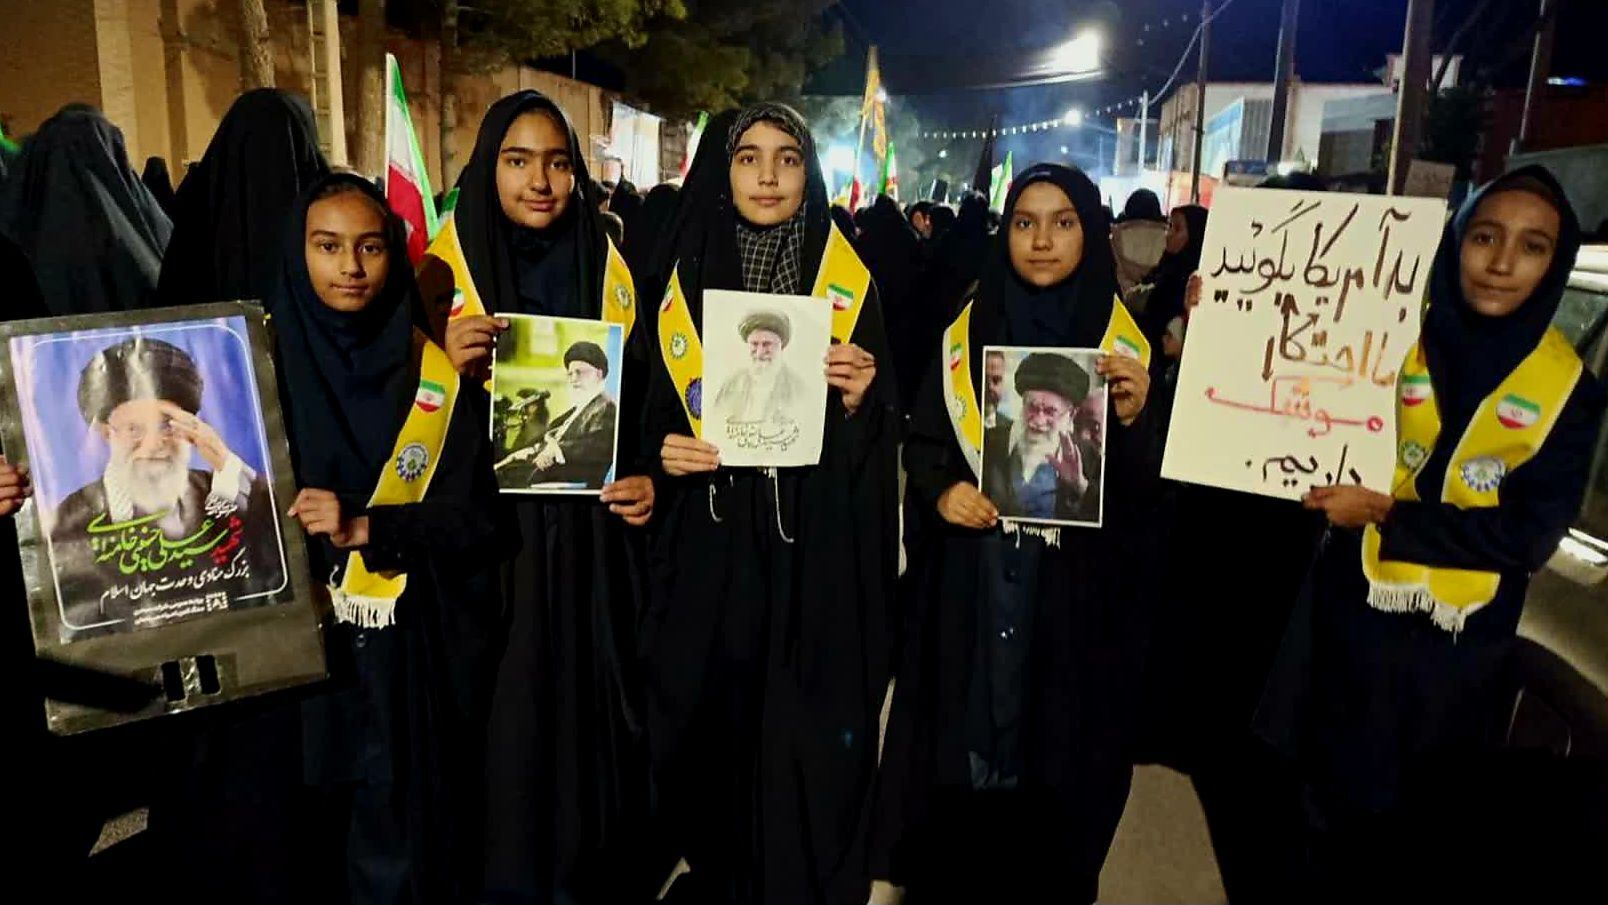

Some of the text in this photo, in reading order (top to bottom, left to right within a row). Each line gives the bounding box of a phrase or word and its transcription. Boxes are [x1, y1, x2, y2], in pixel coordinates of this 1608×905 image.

[1303, 202, 1412, 323] آمریکا
[1371, 331, 1397, 386] ما
[1204, 375, 1384, 440] موشک
[209, 514, 245, 567] شهید
[193, 566, 224, 590] منادی
[224, 546, 251, 580] بزرگ
[100, 583, 130, 614] اسلام
[129, 580, 157, 600] جهان
[156, 575, 194, 592] وحدت
